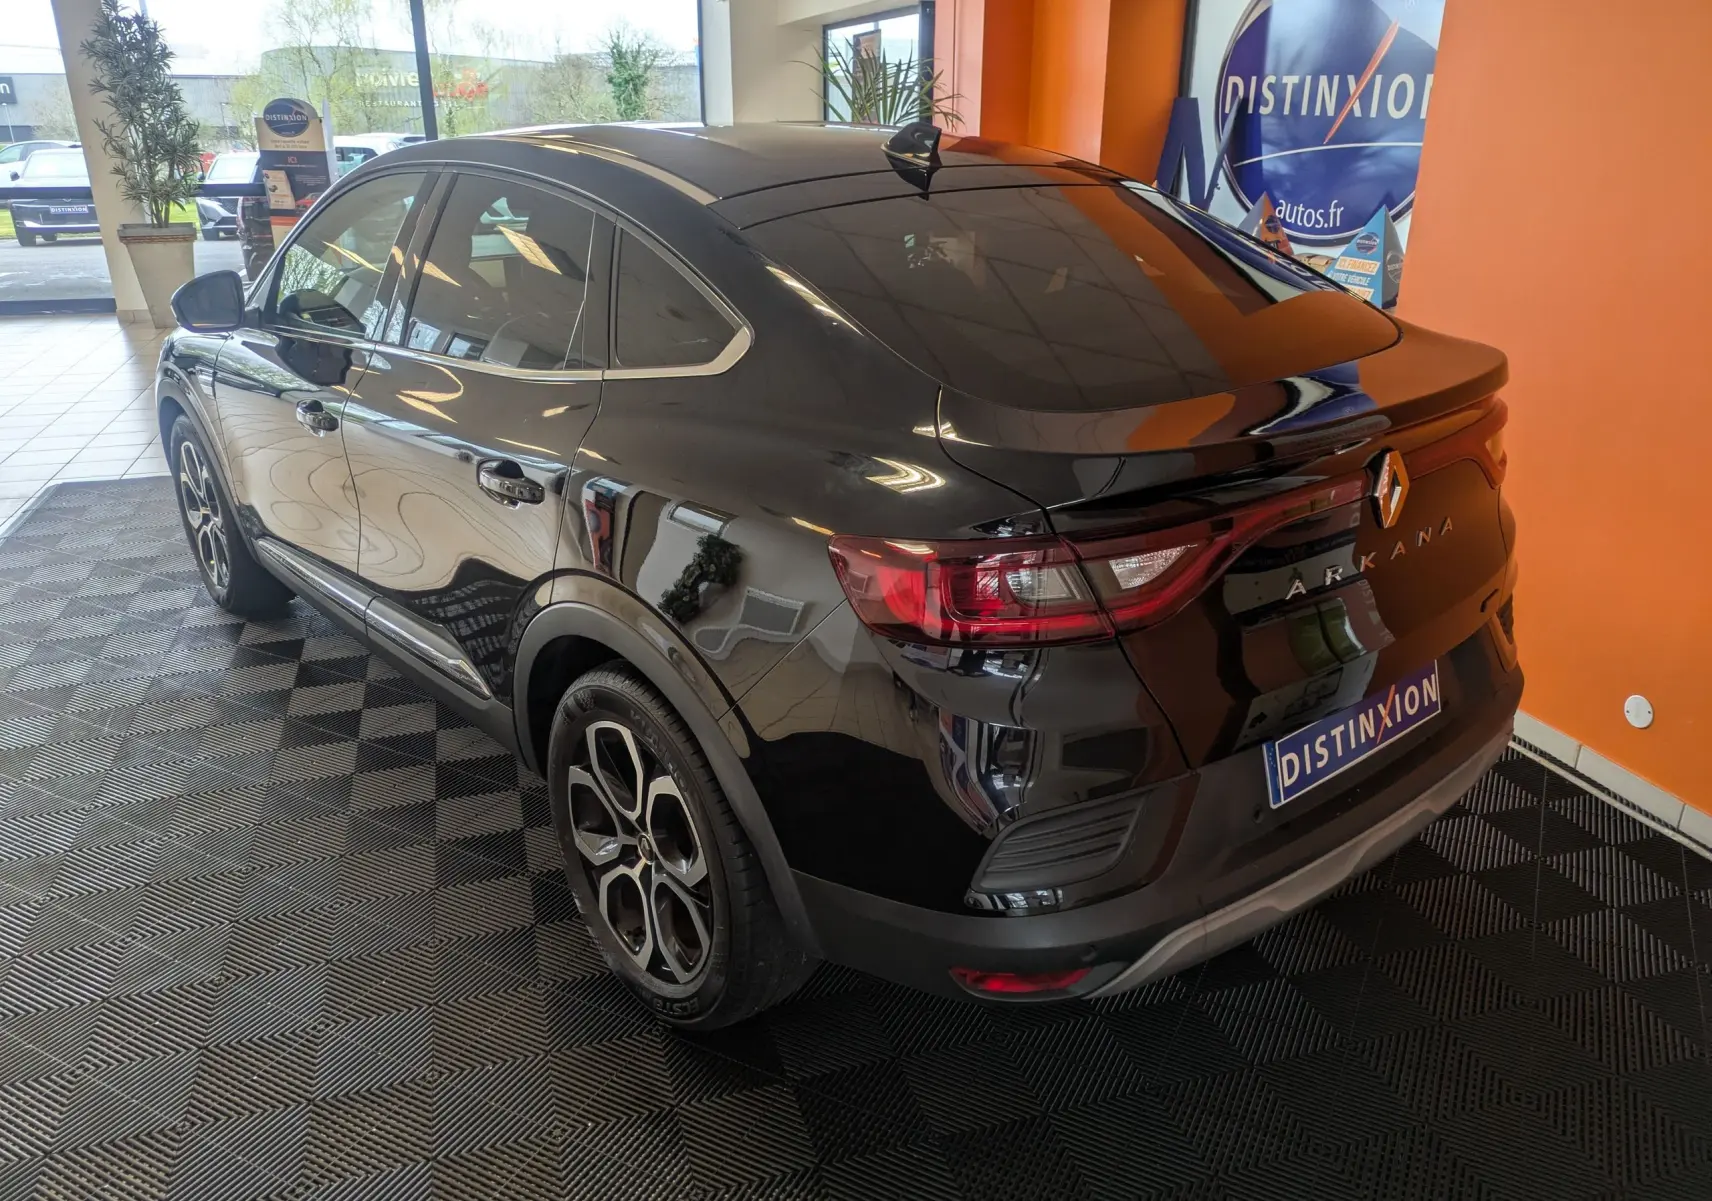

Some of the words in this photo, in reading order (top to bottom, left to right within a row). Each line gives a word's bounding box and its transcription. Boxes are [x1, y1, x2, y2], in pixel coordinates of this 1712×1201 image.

[265, 113, 307, 121] DISTINXION
[1275, 200, 1344, 228] autos.fr
[1286, 517, 1453, 600] ARKANA
[1281, 674, 1437, 788] DISTINXION
